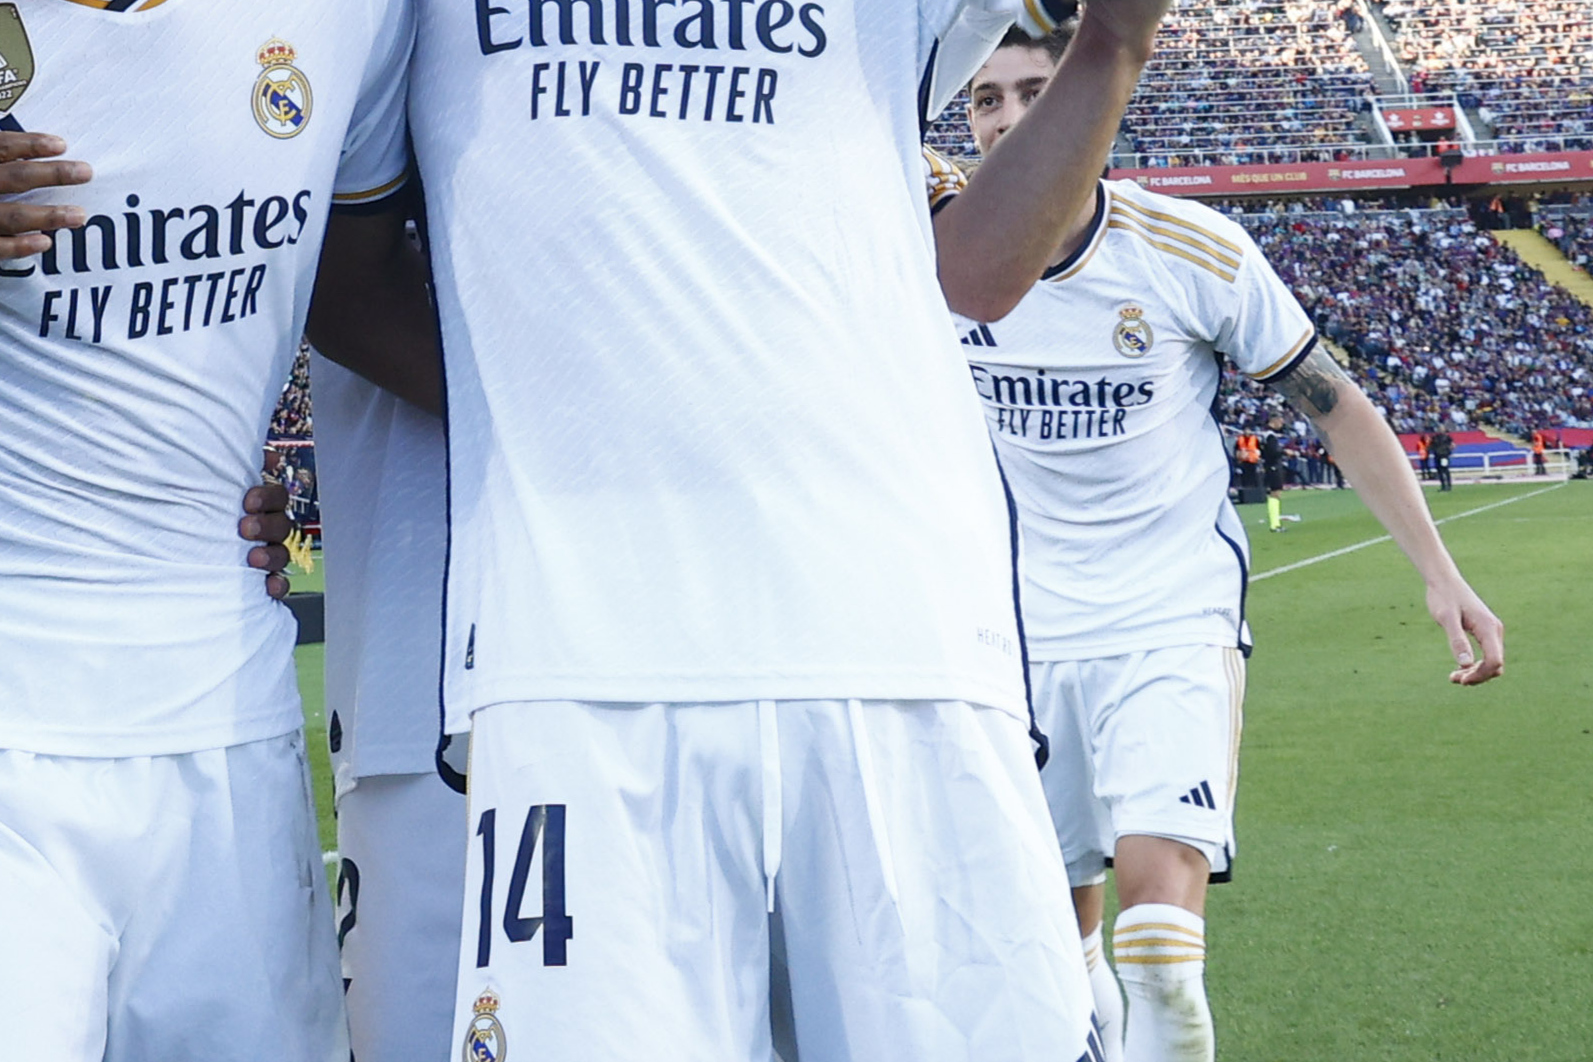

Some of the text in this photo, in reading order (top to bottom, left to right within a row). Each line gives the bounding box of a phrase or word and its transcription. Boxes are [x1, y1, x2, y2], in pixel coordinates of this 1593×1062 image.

[531, 61, 778, 125] FLY BETTER
[1150, 175, 1212, 187] FC BARCELONA
[1342, 168, 1406, 179] FC BARCELONA
[39, 264, 267, 344] FLY BETTER
[998, 408, 1127, 440] FLY BETTER
[476, 804, 573, 968] 14
